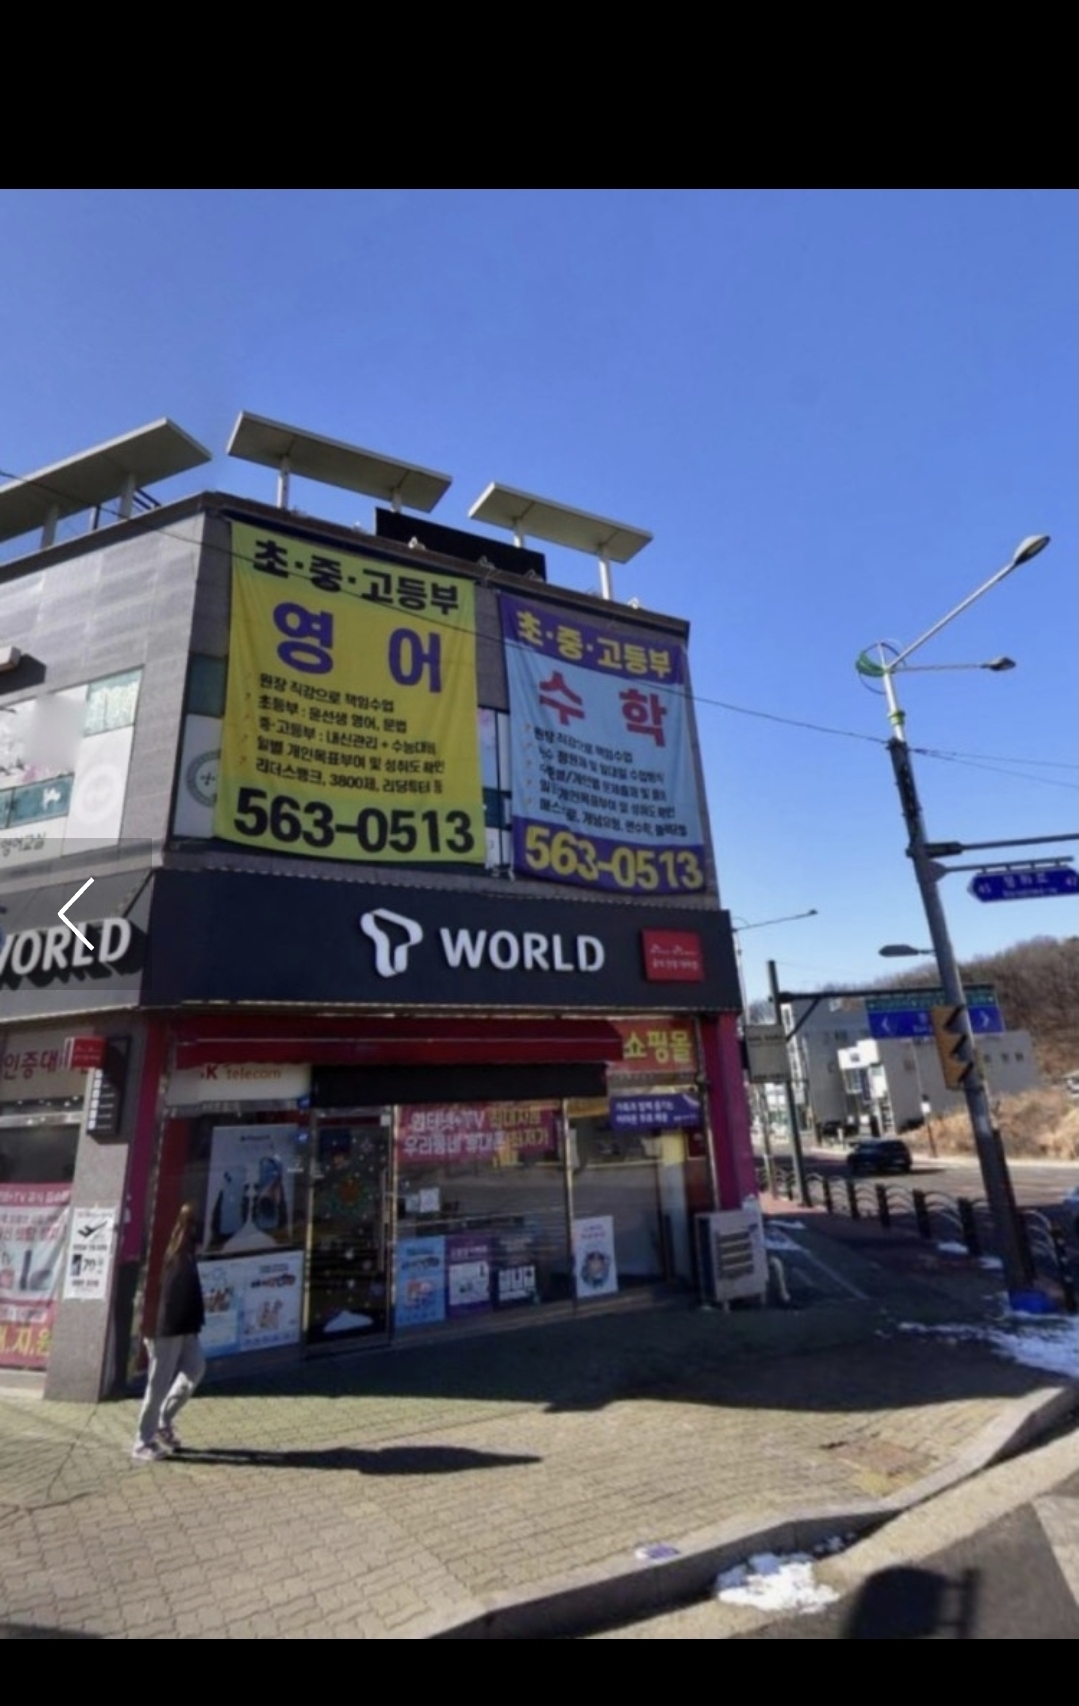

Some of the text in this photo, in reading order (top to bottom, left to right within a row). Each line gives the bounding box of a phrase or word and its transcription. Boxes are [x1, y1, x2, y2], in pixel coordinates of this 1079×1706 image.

[260, 673, 288, 692] 원장
[345, 692, 395, 713] 책임수업
[258, 694, 299, 715] 초등부
[383, 718, 408, 733] 문법
[286, 743, 367, 770] 개인목표부여
[369, 757, 382, 771] 및
[384, 760, 422, 774] 성취도
[326, 730, 378, 751] 내신관리
[233, 787, 475, 854] 563-0513
[524, 825, 704, 890] 563-0513
[439, 927, 606, 972] WORLD
[623, 1030, 693, 1064] 쇼핑몰
[226, 1067, 281, 1081] telecom
